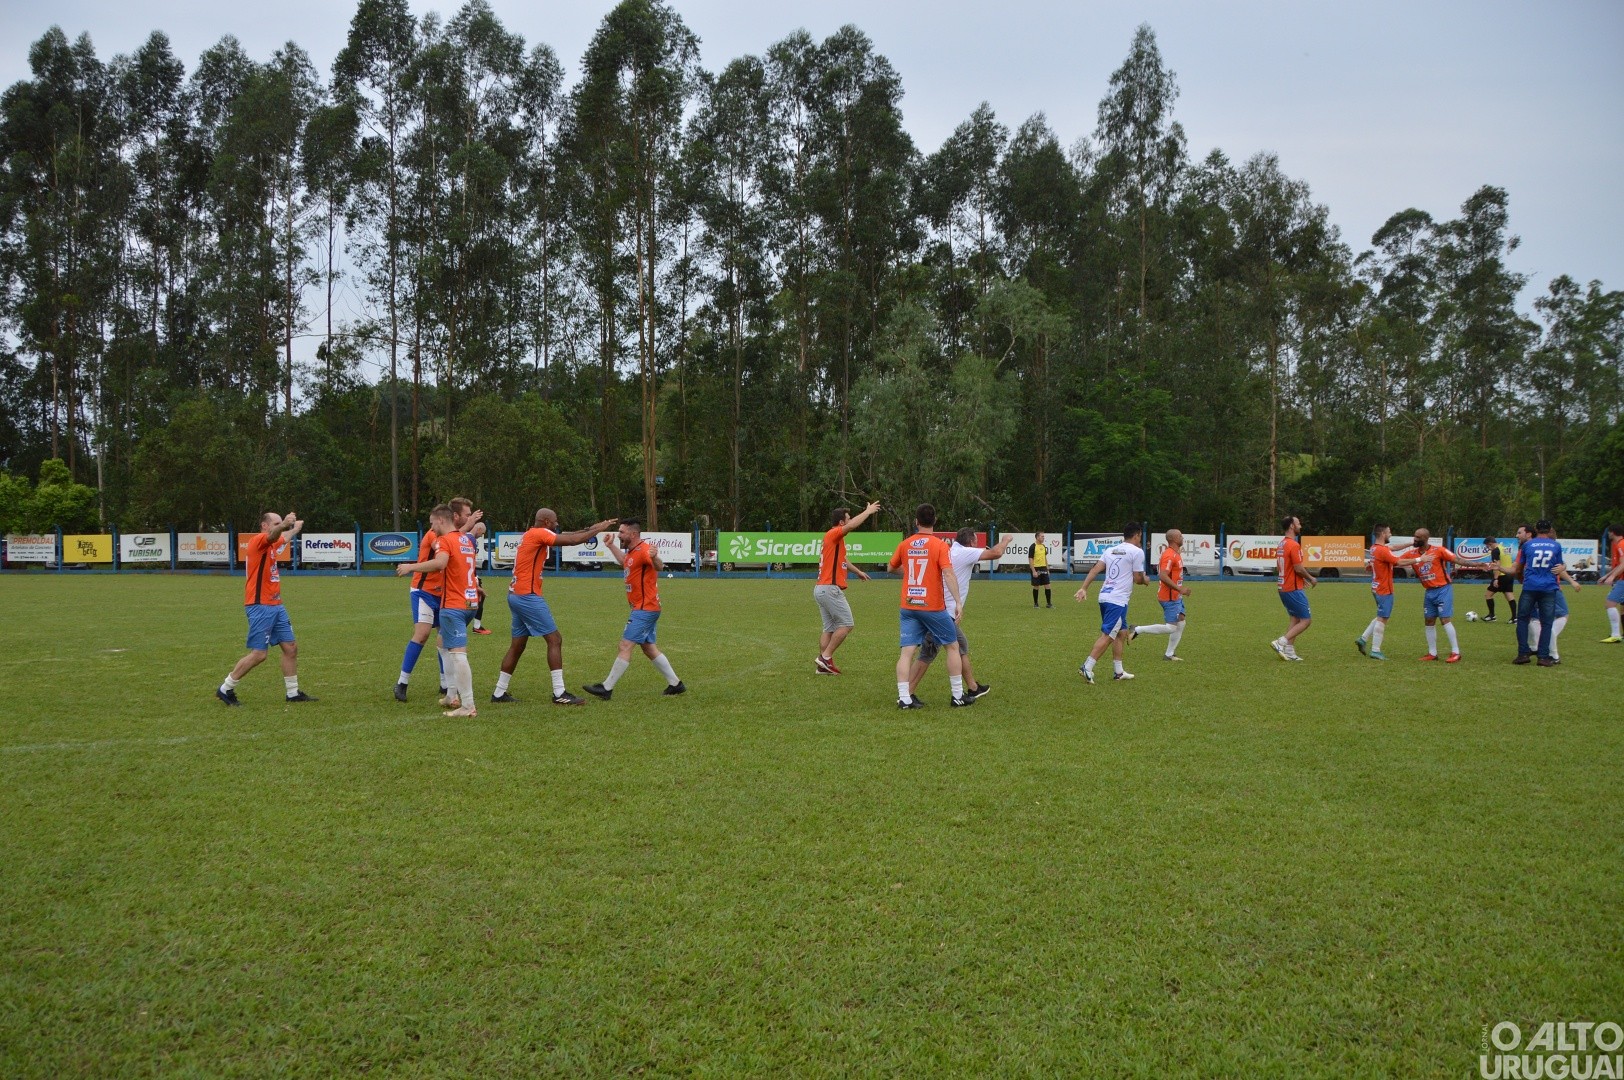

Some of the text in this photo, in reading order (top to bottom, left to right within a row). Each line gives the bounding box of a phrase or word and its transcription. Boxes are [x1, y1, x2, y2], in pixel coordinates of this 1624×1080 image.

[306, 540, 352, 551] RefreeMaq
[504, 541, 518, 549] Agê
[755, 539, 823, 556] Sicredi
[1460, 544, 1480, 554] Dent
[128, 549, 162, 557] TURISMO
[1532, 550, 1553, 568] 22
[908, 558, 928, 586] 17
[1108, 558, 1122, 580] 6
